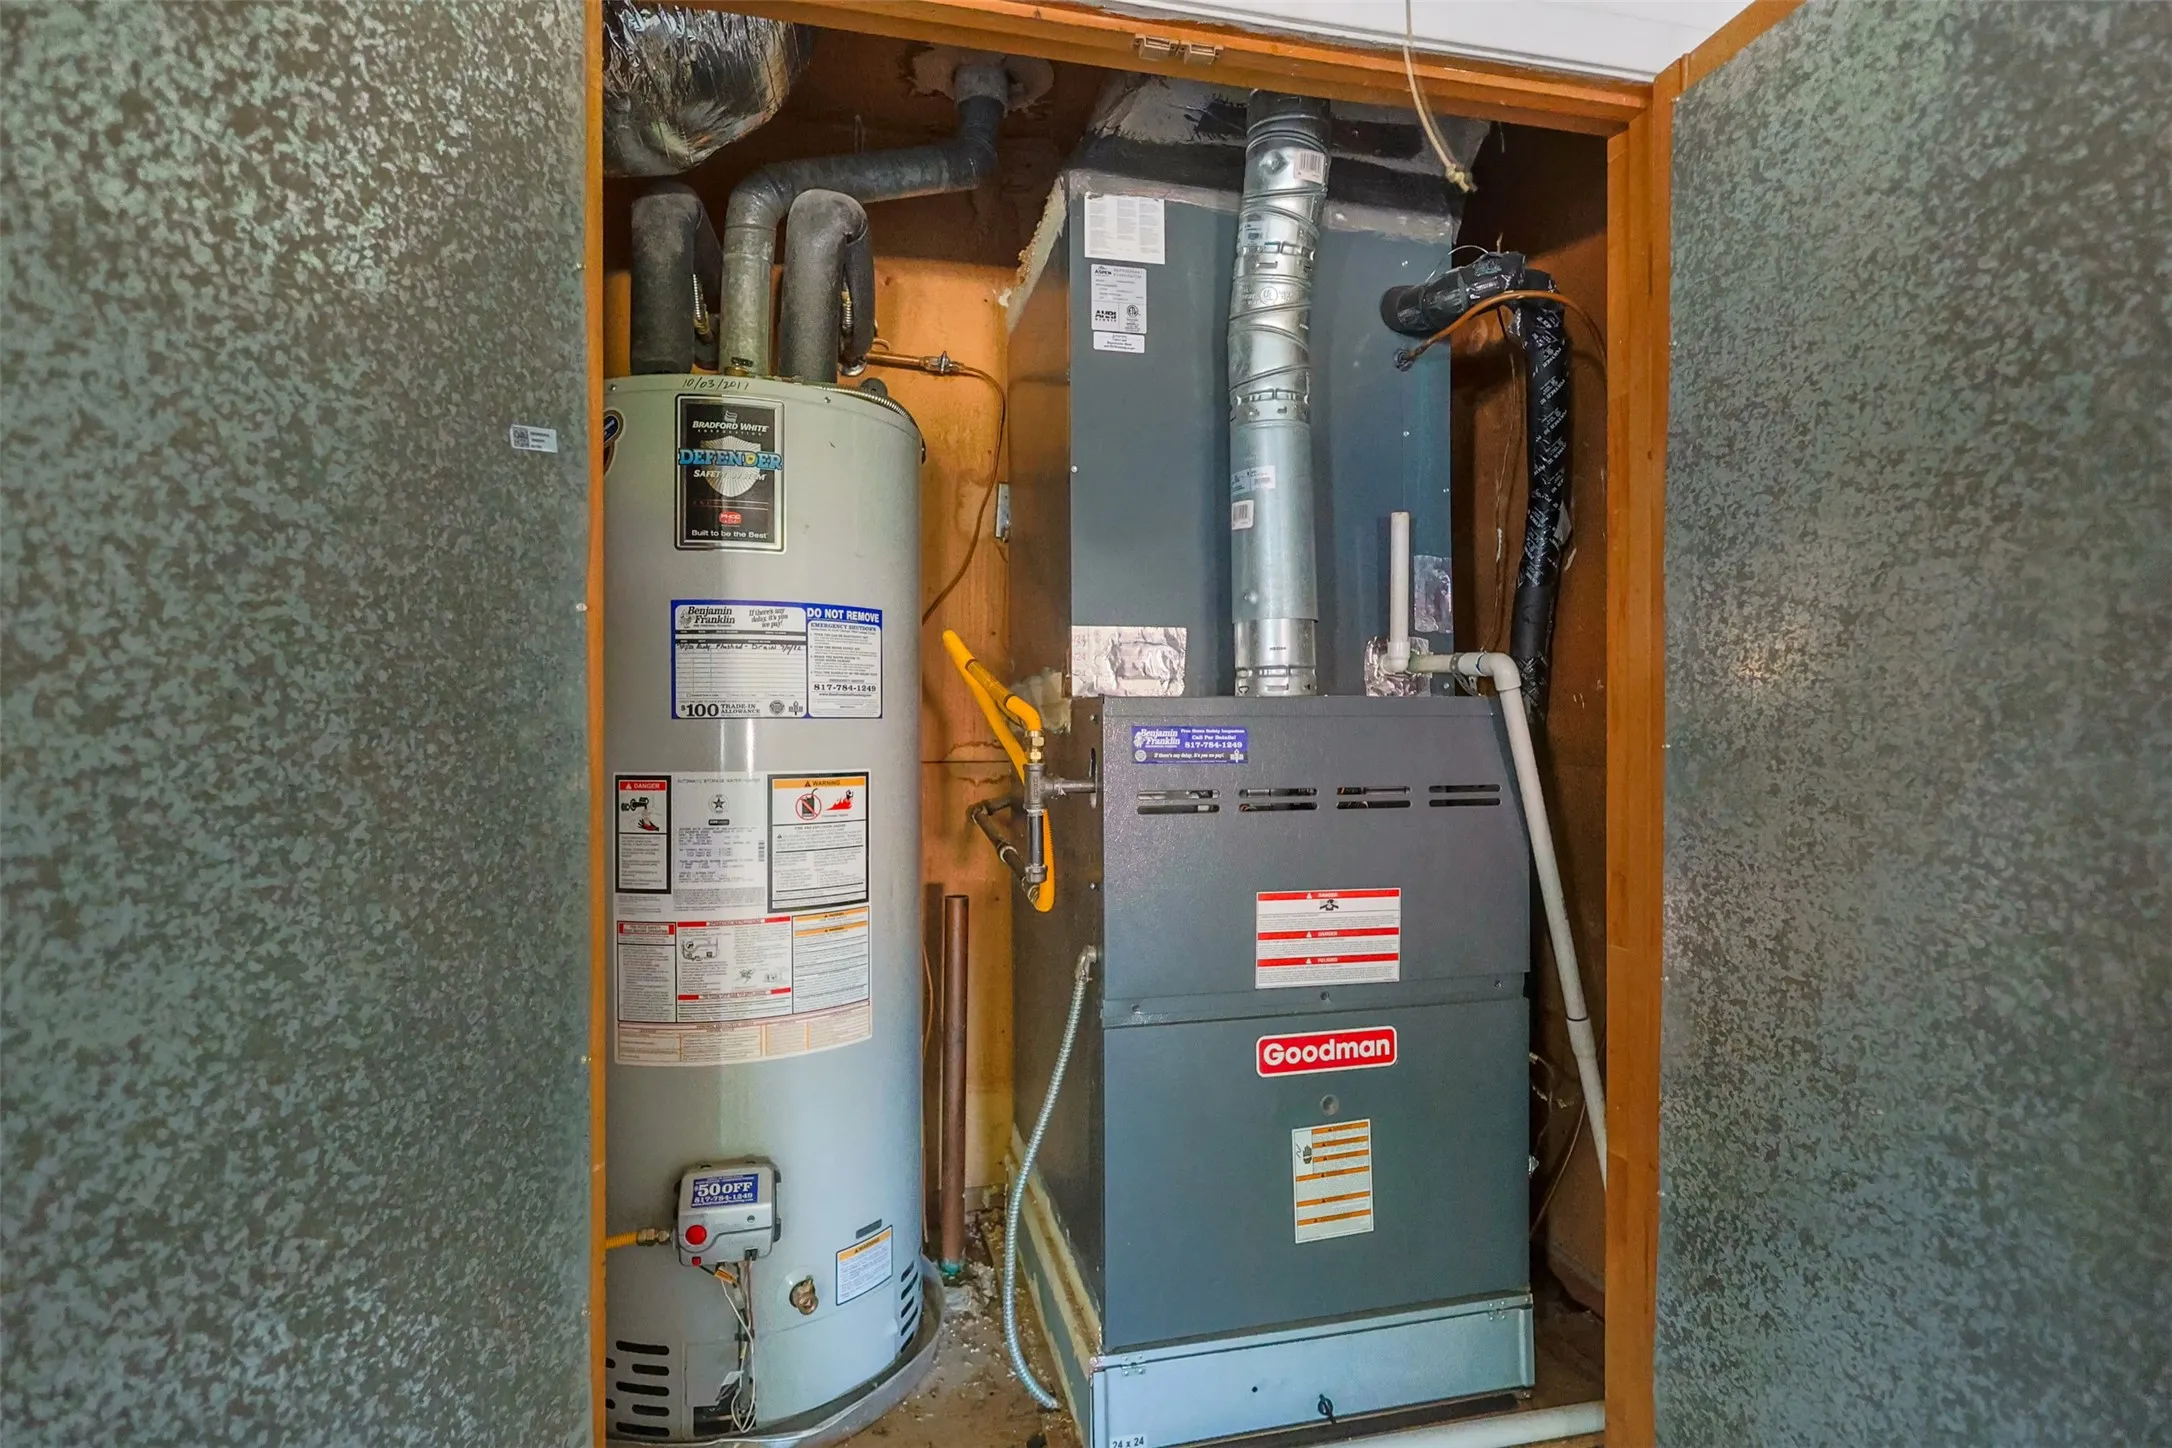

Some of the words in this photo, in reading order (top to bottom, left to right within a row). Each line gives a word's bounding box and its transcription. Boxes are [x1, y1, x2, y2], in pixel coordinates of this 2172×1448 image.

[692, 420, 738, 430] BRADFORD
[740, 423, 769, 433] WHITE
[679, 448, 783, 470] DEFENDER
[691, 529, 709, 537] Built
[748, 531, 767, 539] Best
[688, 606, 732, 616] Benjamin
[807, 607, 822, 618] DO
[824, 609, 844, 619] NOT
[846, 610, 880, 623] REMOVE
[694, 614, 735, 624] Franklin
[814, 684, 877, 692] 817-784-1249
[681, 703, 719, 717] $100
[1140, 729, 1178, 739] Benjamin
[1145, 736, 1180, 745] Franklin
[1184, 741, 1243, 749] 817-784-1249
[1263, 1038, 1391, 1066] Goodman
[721, 1181, 753, 1193] OFF
[694, 1193, 753, 1203] 817-784-1249
[1112, 1440, 1123, 1448] 24
[1134, 1436, 1144, 1447] 24
